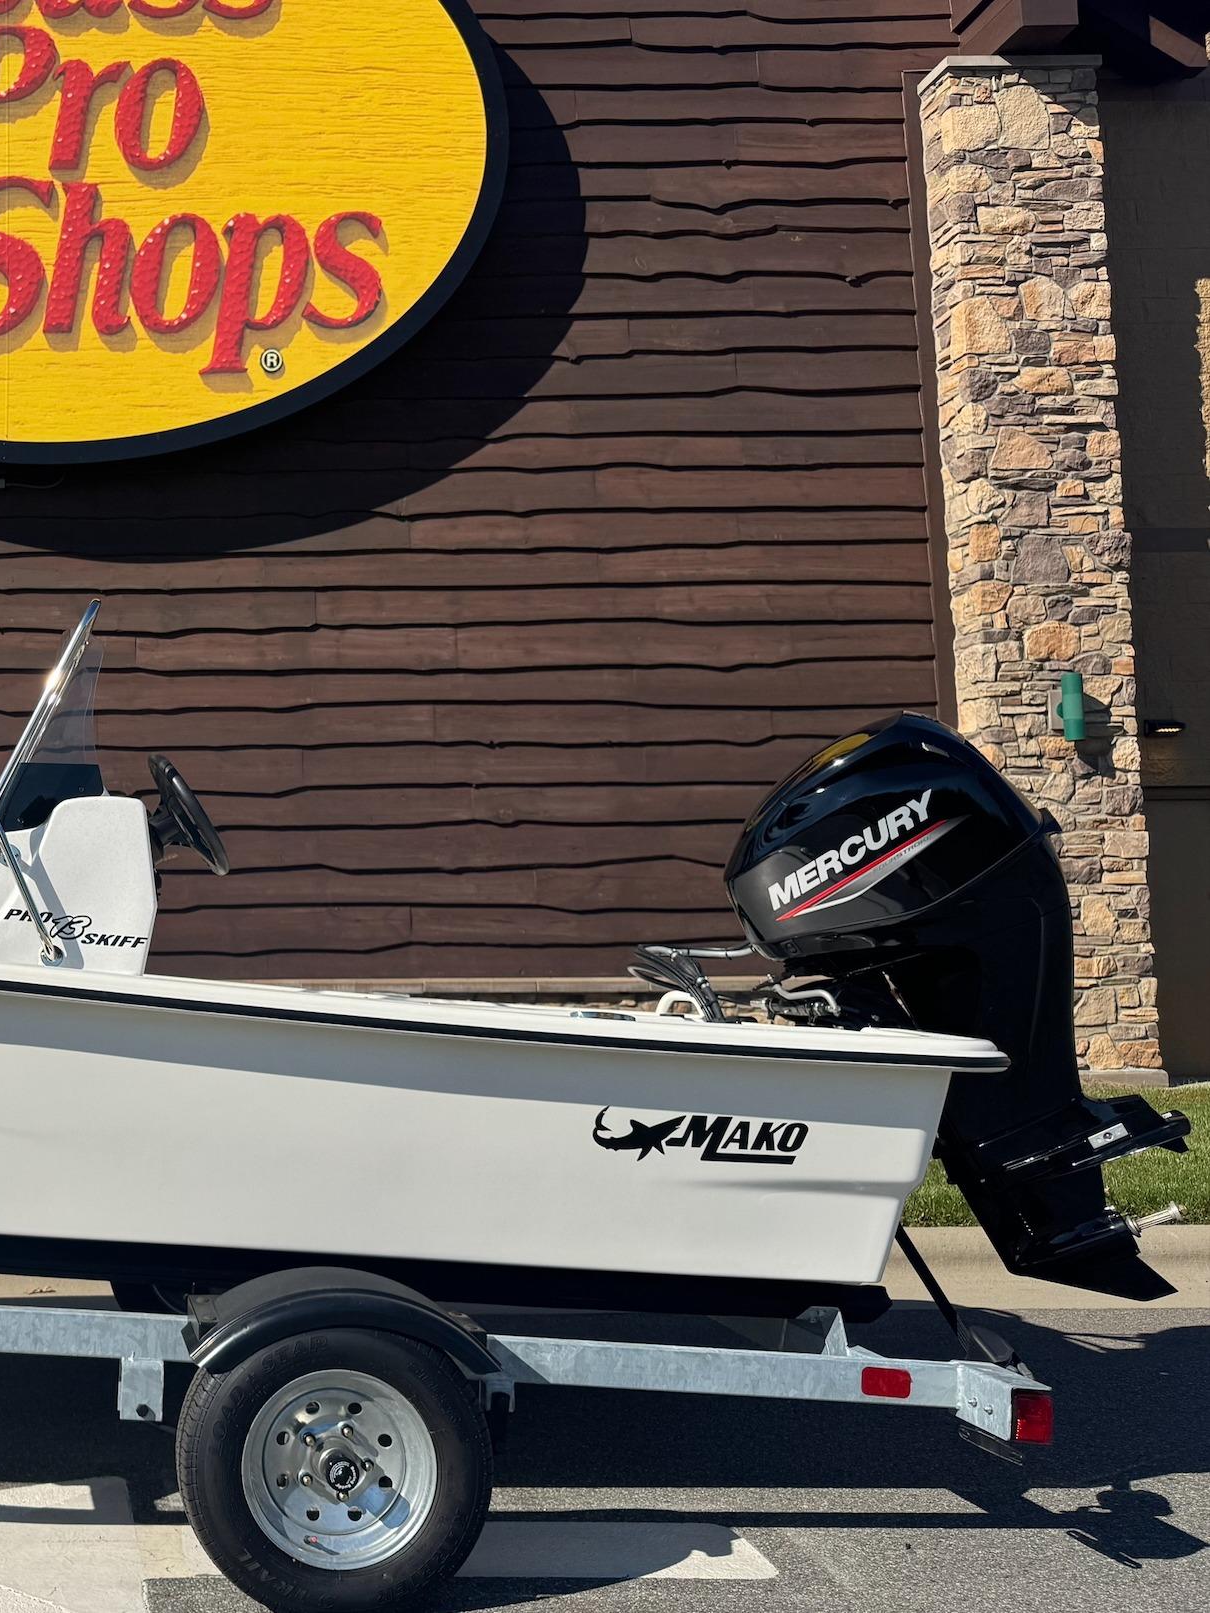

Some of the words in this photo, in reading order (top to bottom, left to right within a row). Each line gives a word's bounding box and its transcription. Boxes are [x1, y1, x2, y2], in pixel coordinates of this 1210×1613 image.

[767, 788, 932, 911] MERCURY
[80, 933, 148, 948] SKIFF
[665, 1115, 809, 1165] MAKO
